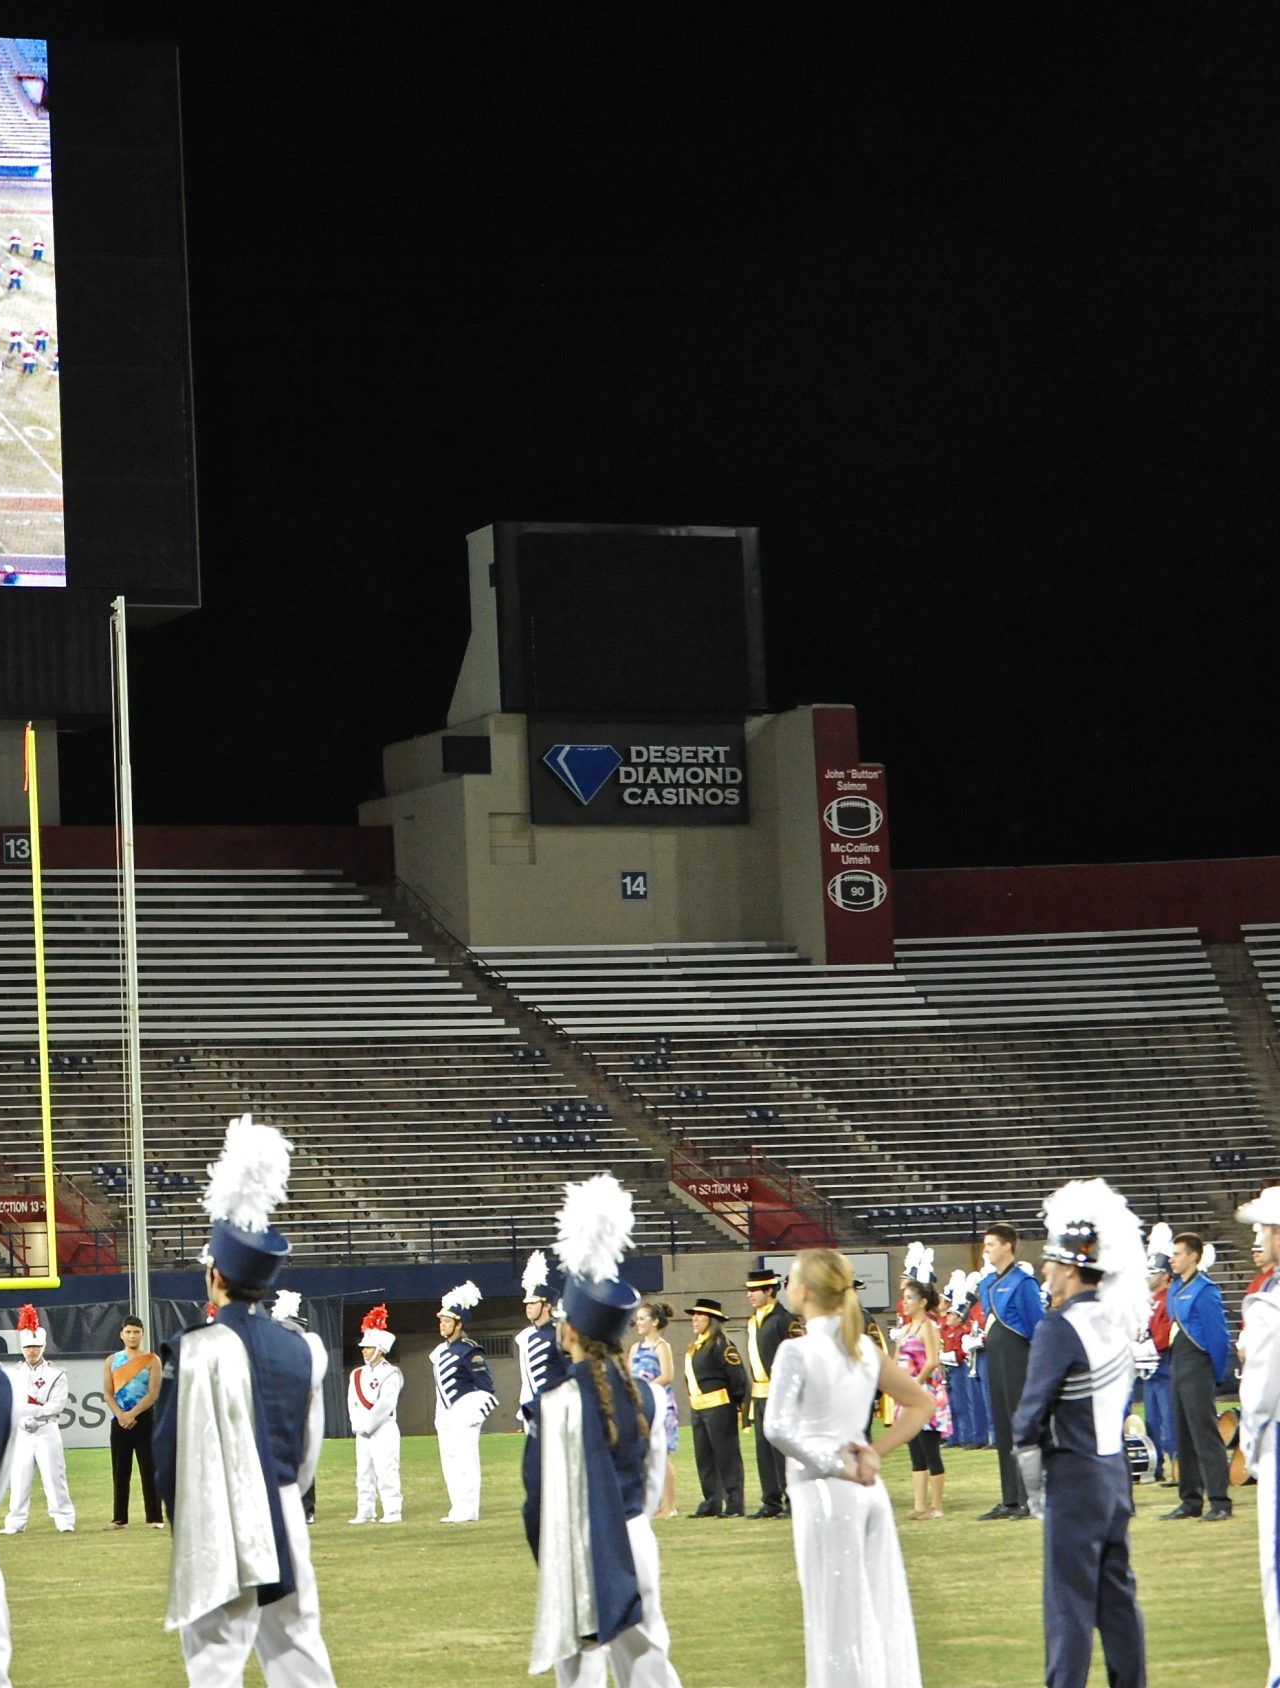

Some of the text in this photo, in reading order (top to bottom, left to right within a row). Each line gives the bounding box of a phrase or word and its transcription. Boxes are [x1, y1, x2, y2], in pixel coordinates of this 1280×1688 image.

[630, 746, 730, 764] DESERT
[619, 767, 743, 785] DIAMOND
[824, 769, 845, 780] John
[837, 781, 867, 791] Salmon
[623, 788, 740, 806] CASINOS
[5, 838, 31, 859] 13
[830, 843, 880, 853] McCollins
[841, 854, 871, 865] Umeh
[622, 876, 646, 896] 14
[850, 886, 865, 897] 90
[30, 1201, 39, 1212] 13
